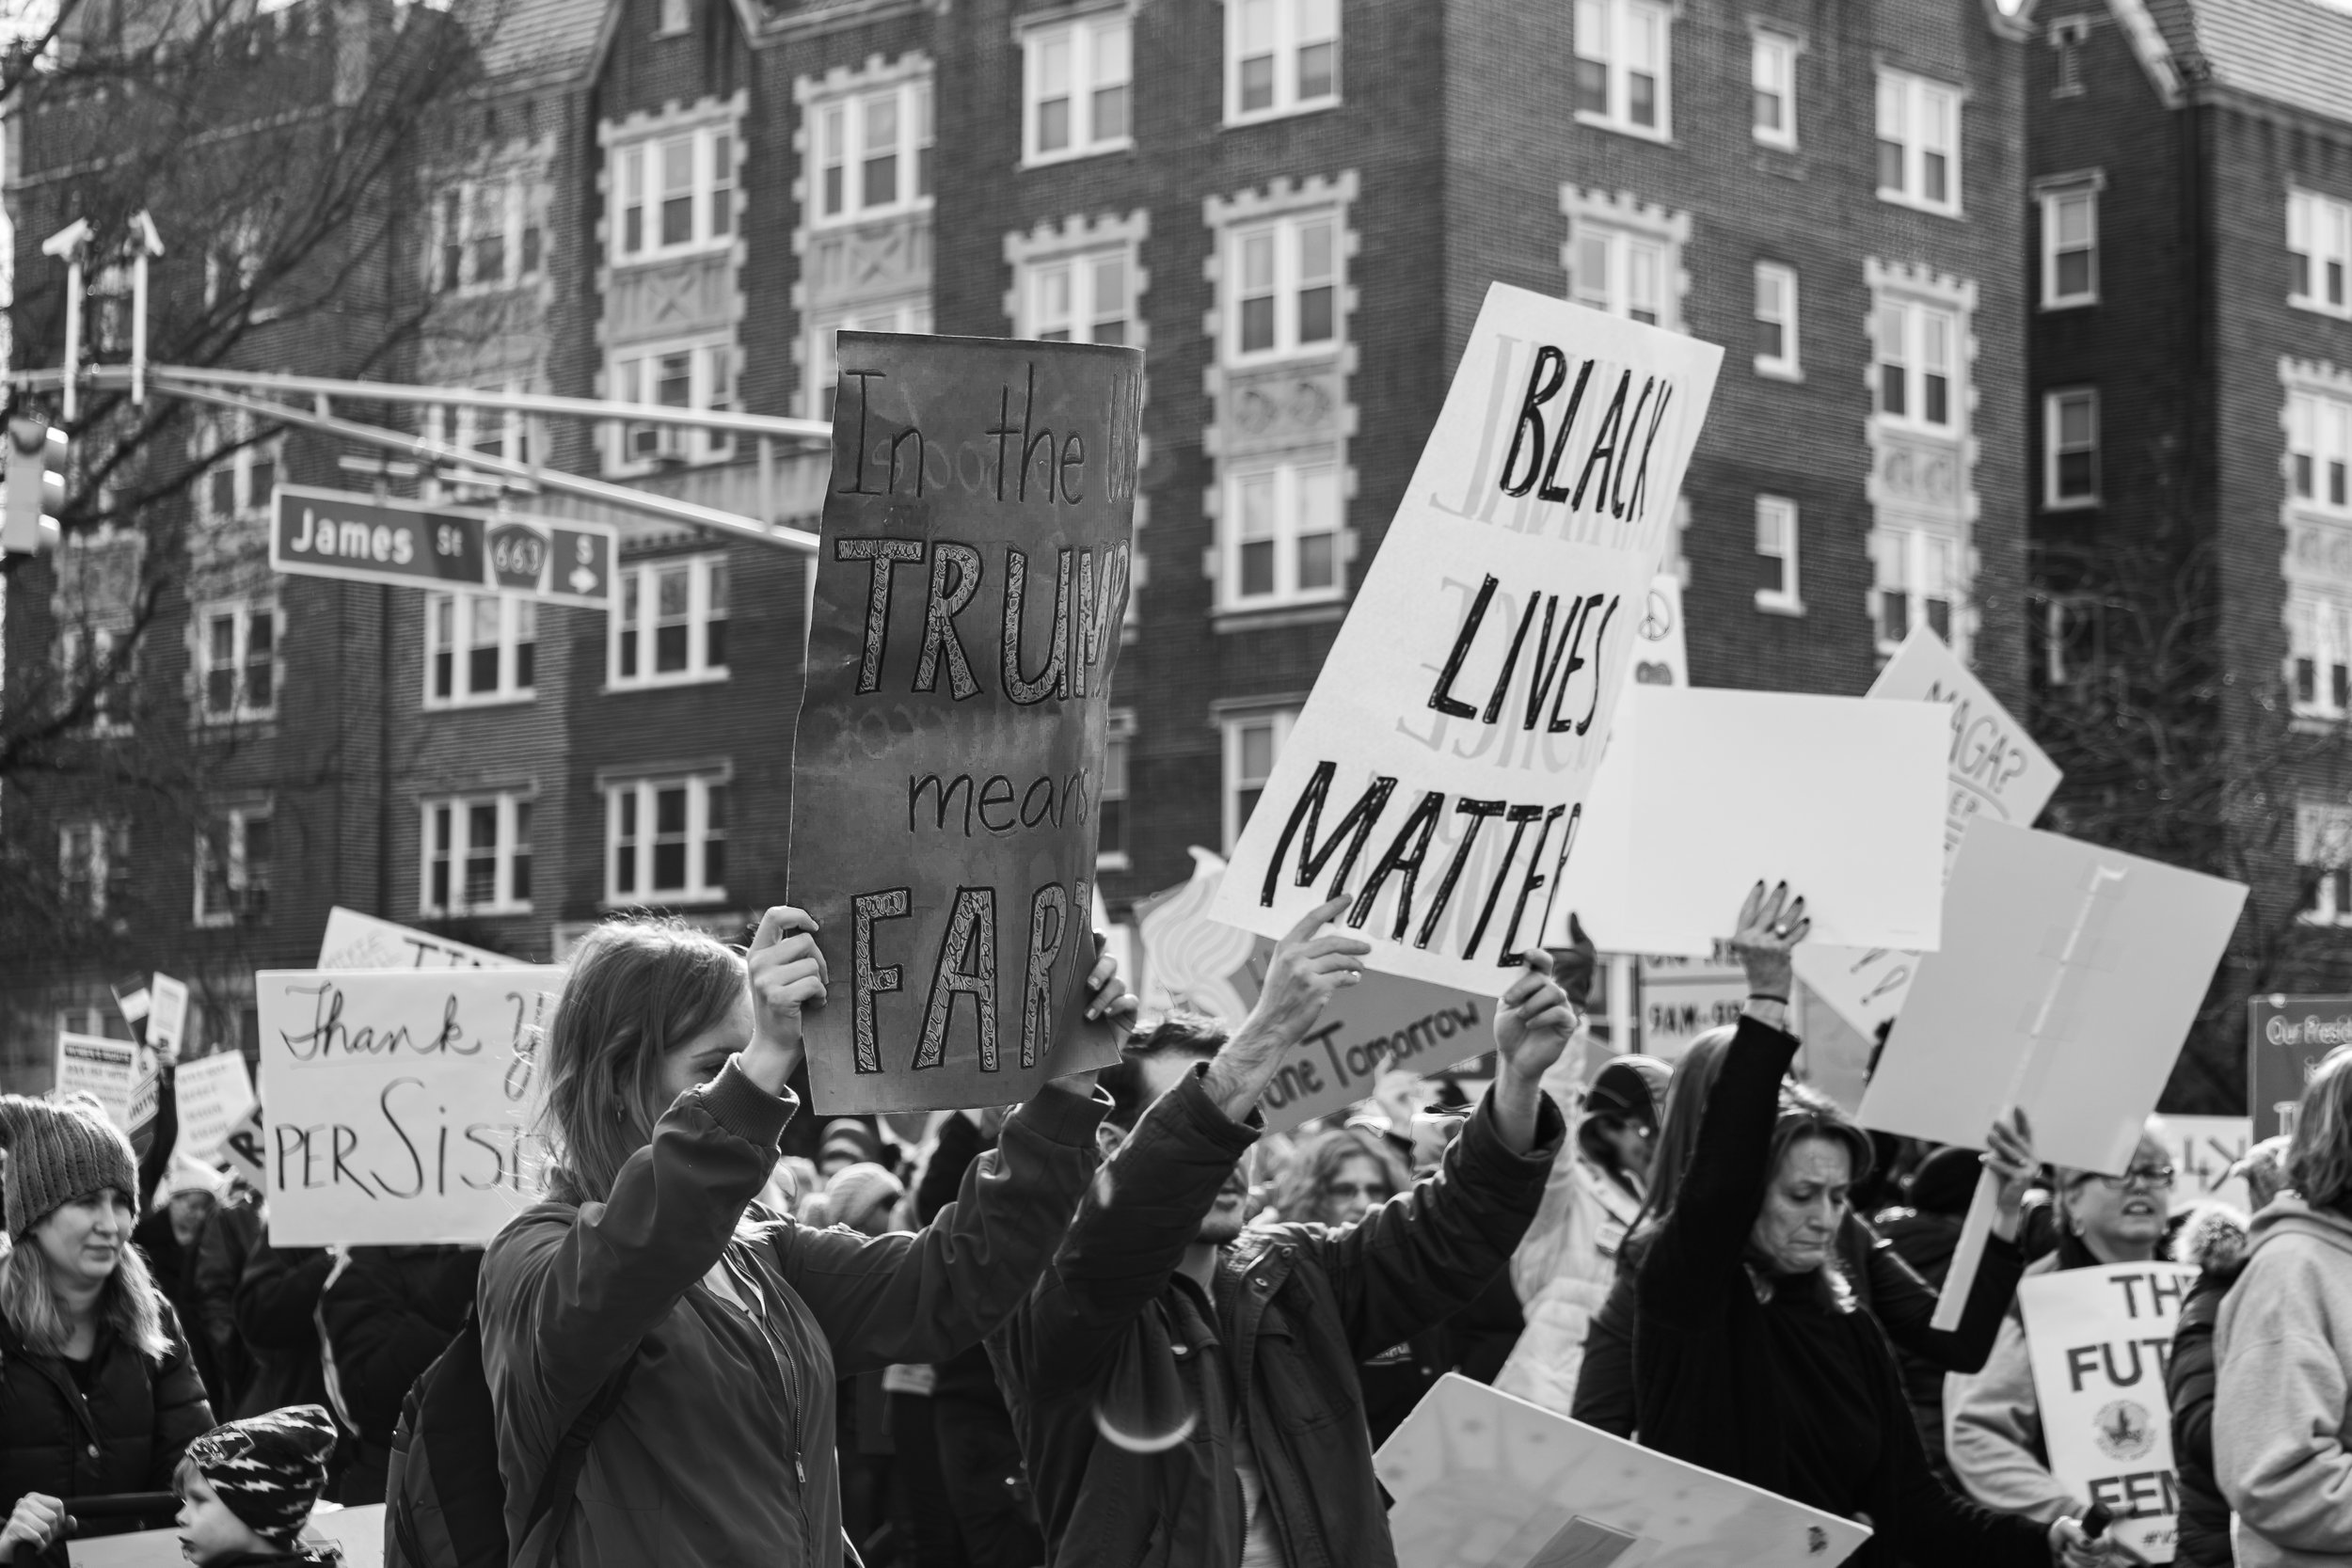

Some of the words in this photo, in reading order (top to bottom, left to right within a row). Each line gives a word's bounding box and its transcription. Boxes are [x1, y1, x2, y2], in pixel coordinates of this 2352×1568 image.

[836, 368, 925, 499] In
[985, 361, 1085, 505] the
[1499, 344, 1673, 523] BLACK
[290, 507, 414, 565] James
[436, 523, 465, 558] St
[834, 537, 1131, 706] TRUMP
[1426, 572, 1620, 736] LIVES
[907, 767, 1089, 838] means
[278, 980, 483, 1062] Thank
[1256, 1058, 1326, 1111] one
[1299, 1000, 1481, 1089] Tomorrow
[2108, 1273, 2190, 1319] TH
